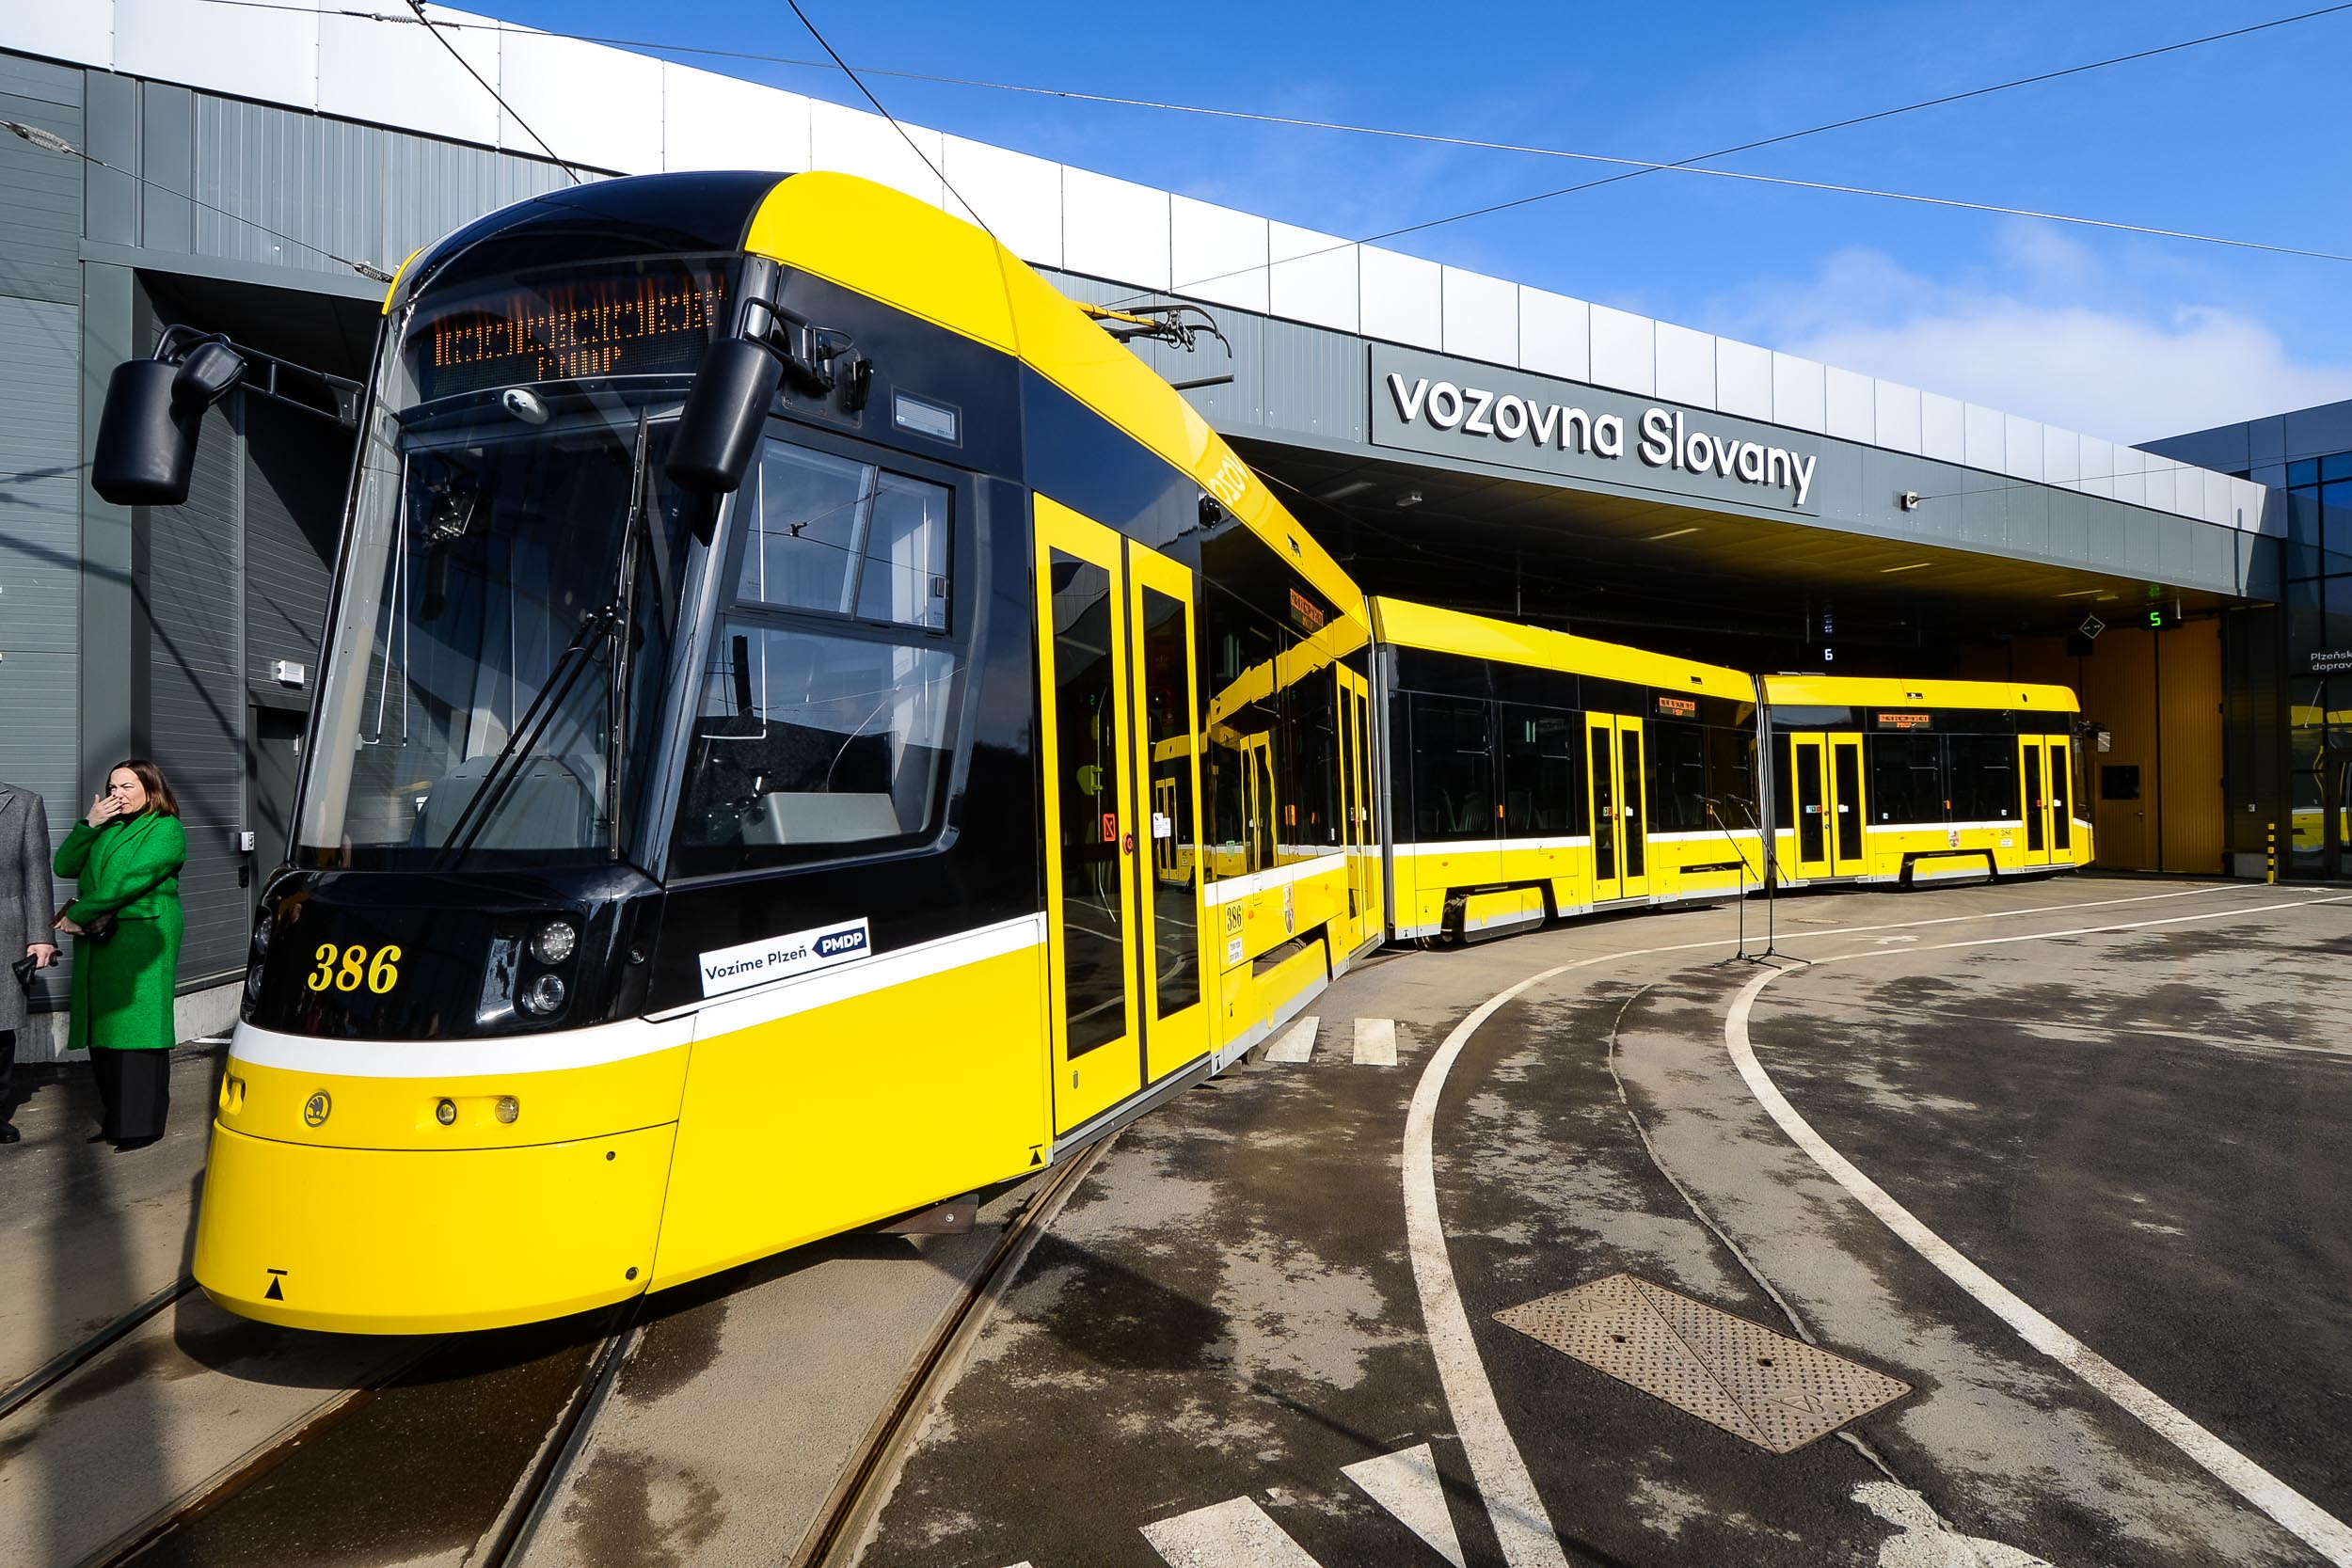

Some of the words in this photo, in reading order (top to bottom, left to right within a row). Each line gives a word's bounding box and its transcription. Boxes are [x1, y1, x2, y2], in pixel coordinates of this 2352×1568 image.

[1638, 407, 1817, 507] Slovany
[2150, 611, 2161, 626] 5
[1824, 648, 1834, 660] 6
[1227, 905, 1242, 931] 386
[822, 932, 864, 954] PMDP
[308, 943, 402, 994] 386
[706, 959, 763, 980] Vozíme
[768, 945, 807, 965] Plzeň
